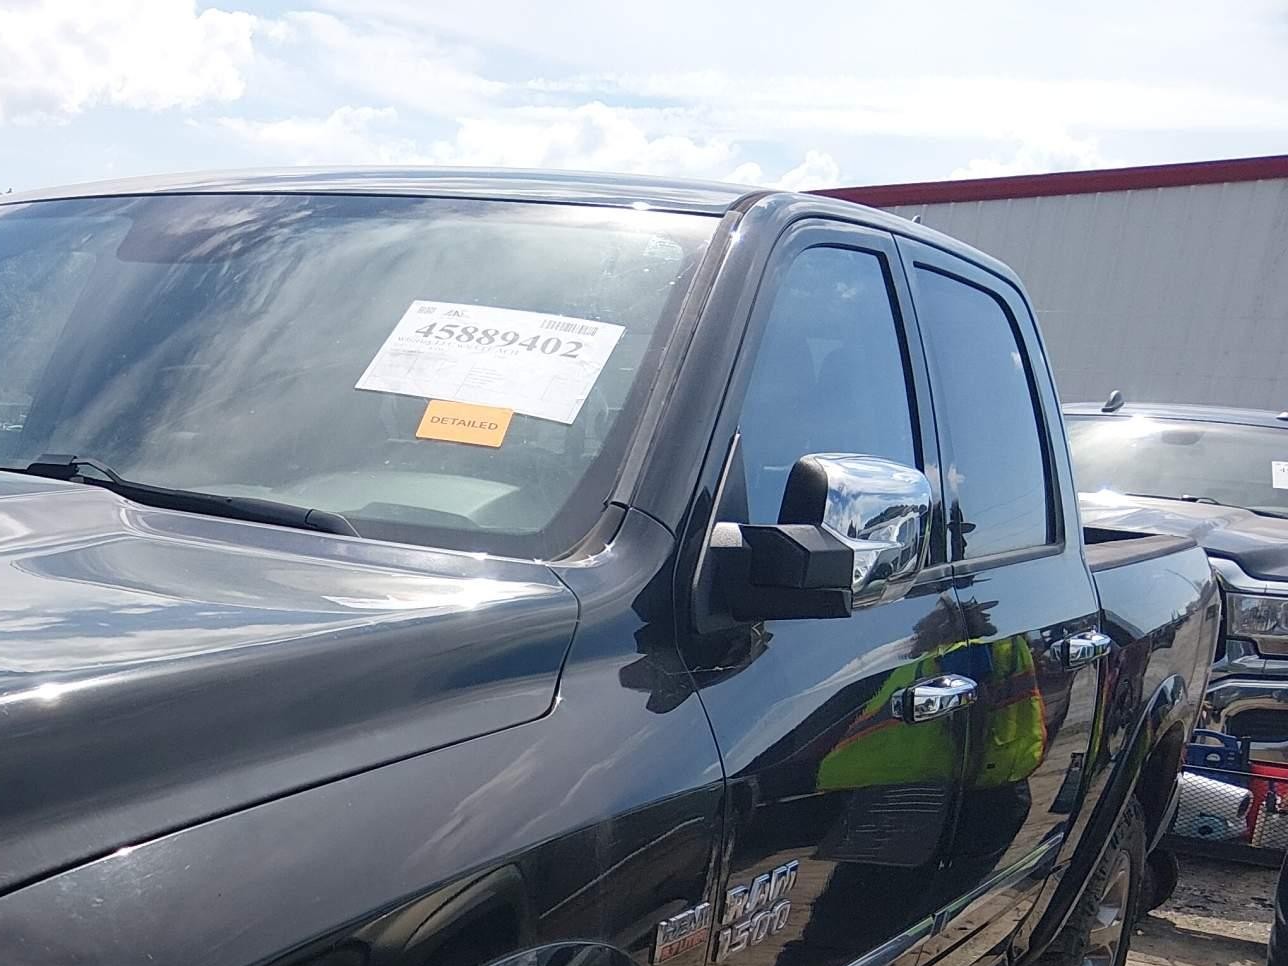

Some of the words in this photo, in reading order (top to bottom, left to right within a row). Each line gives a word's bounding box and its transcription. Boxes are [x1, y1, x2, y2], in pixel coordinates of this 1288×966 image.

[415, 321, 584, 359] 45889402
[429, 414, 499, 432] DETAILED
[721, 859, 800, 926] RAM
[715, 898, 792, 964] 1500
